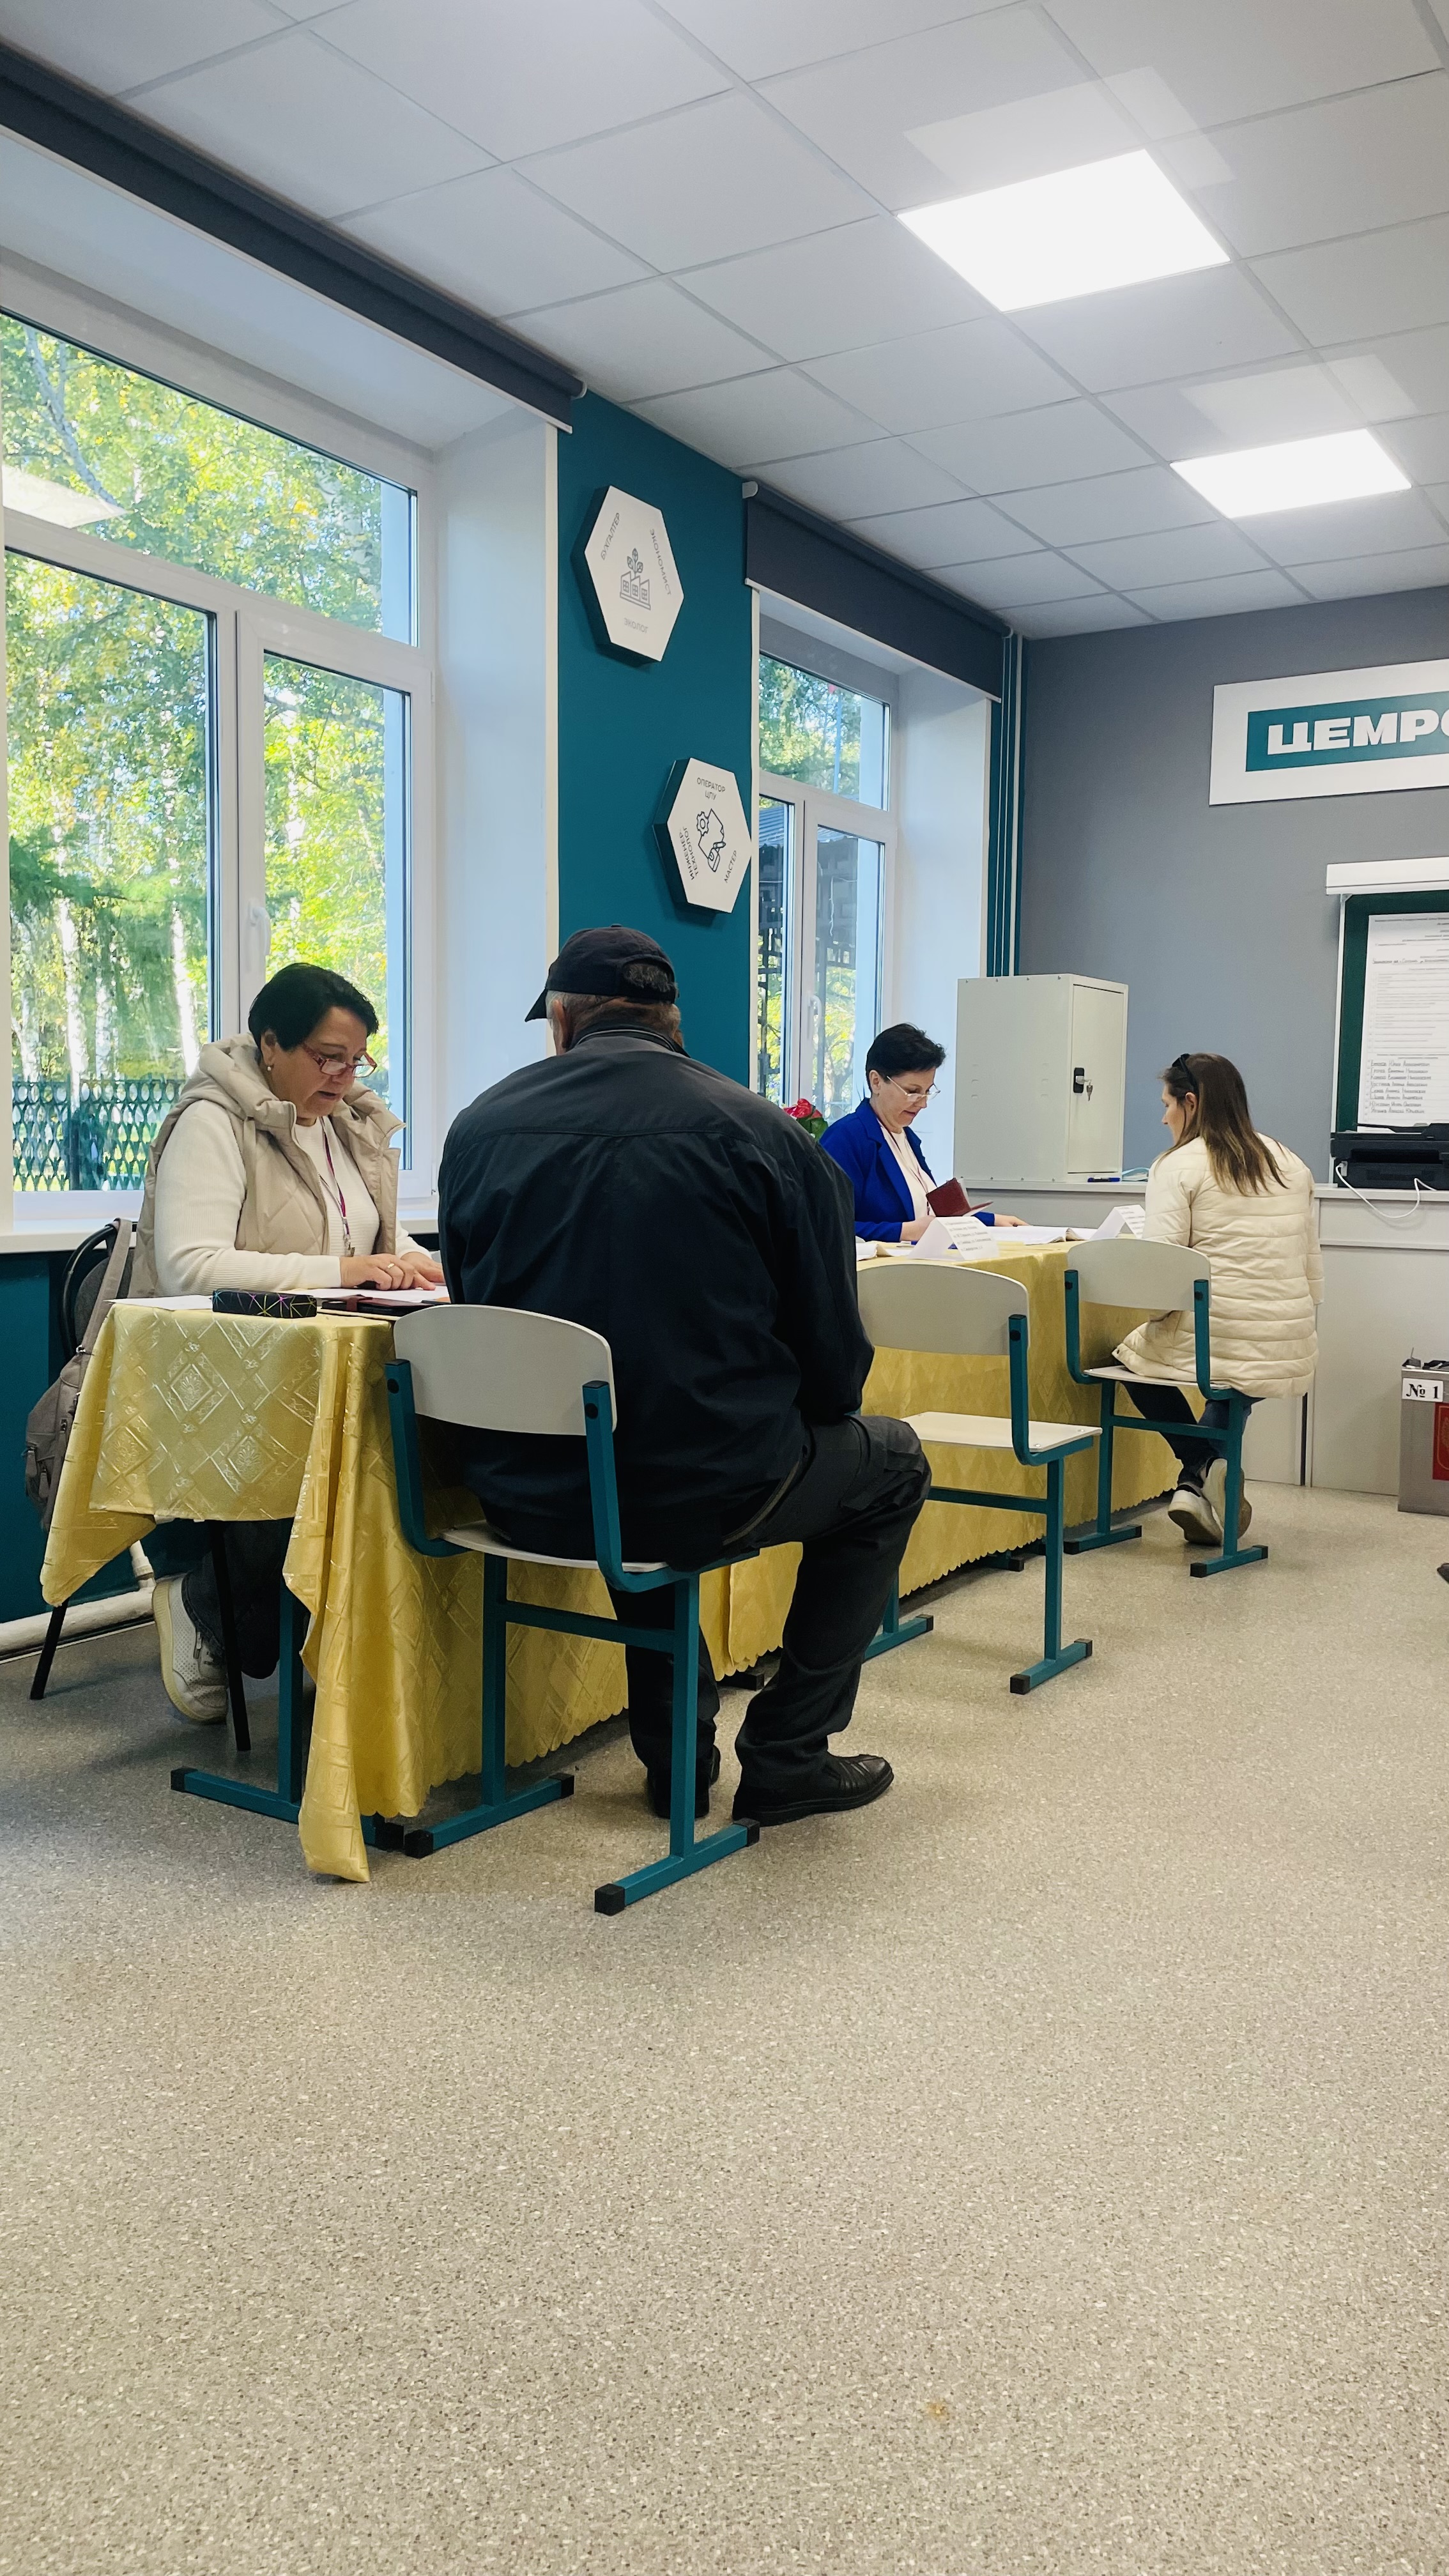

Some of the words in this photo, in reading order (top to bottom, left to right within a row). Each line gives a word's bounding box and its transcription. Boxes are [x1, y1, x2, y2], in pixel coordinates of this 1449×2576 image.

[601, 512, 620, 561] БУХГАЛТЕР
[650, 528, 671, 595] ЭКОНОМИСТ
[1268, 709, 1449, 755] ЦЕМР
[696, 777, 726, 792] ОПЕРАТОР
[683, 825, 698, 877] ТЕХНОЛОГ
[724, 850, 737, 884] МАСТЕР
[1406, 1383, 1425, 1398] №
[1433, 1386, 1439, 1399] 1
